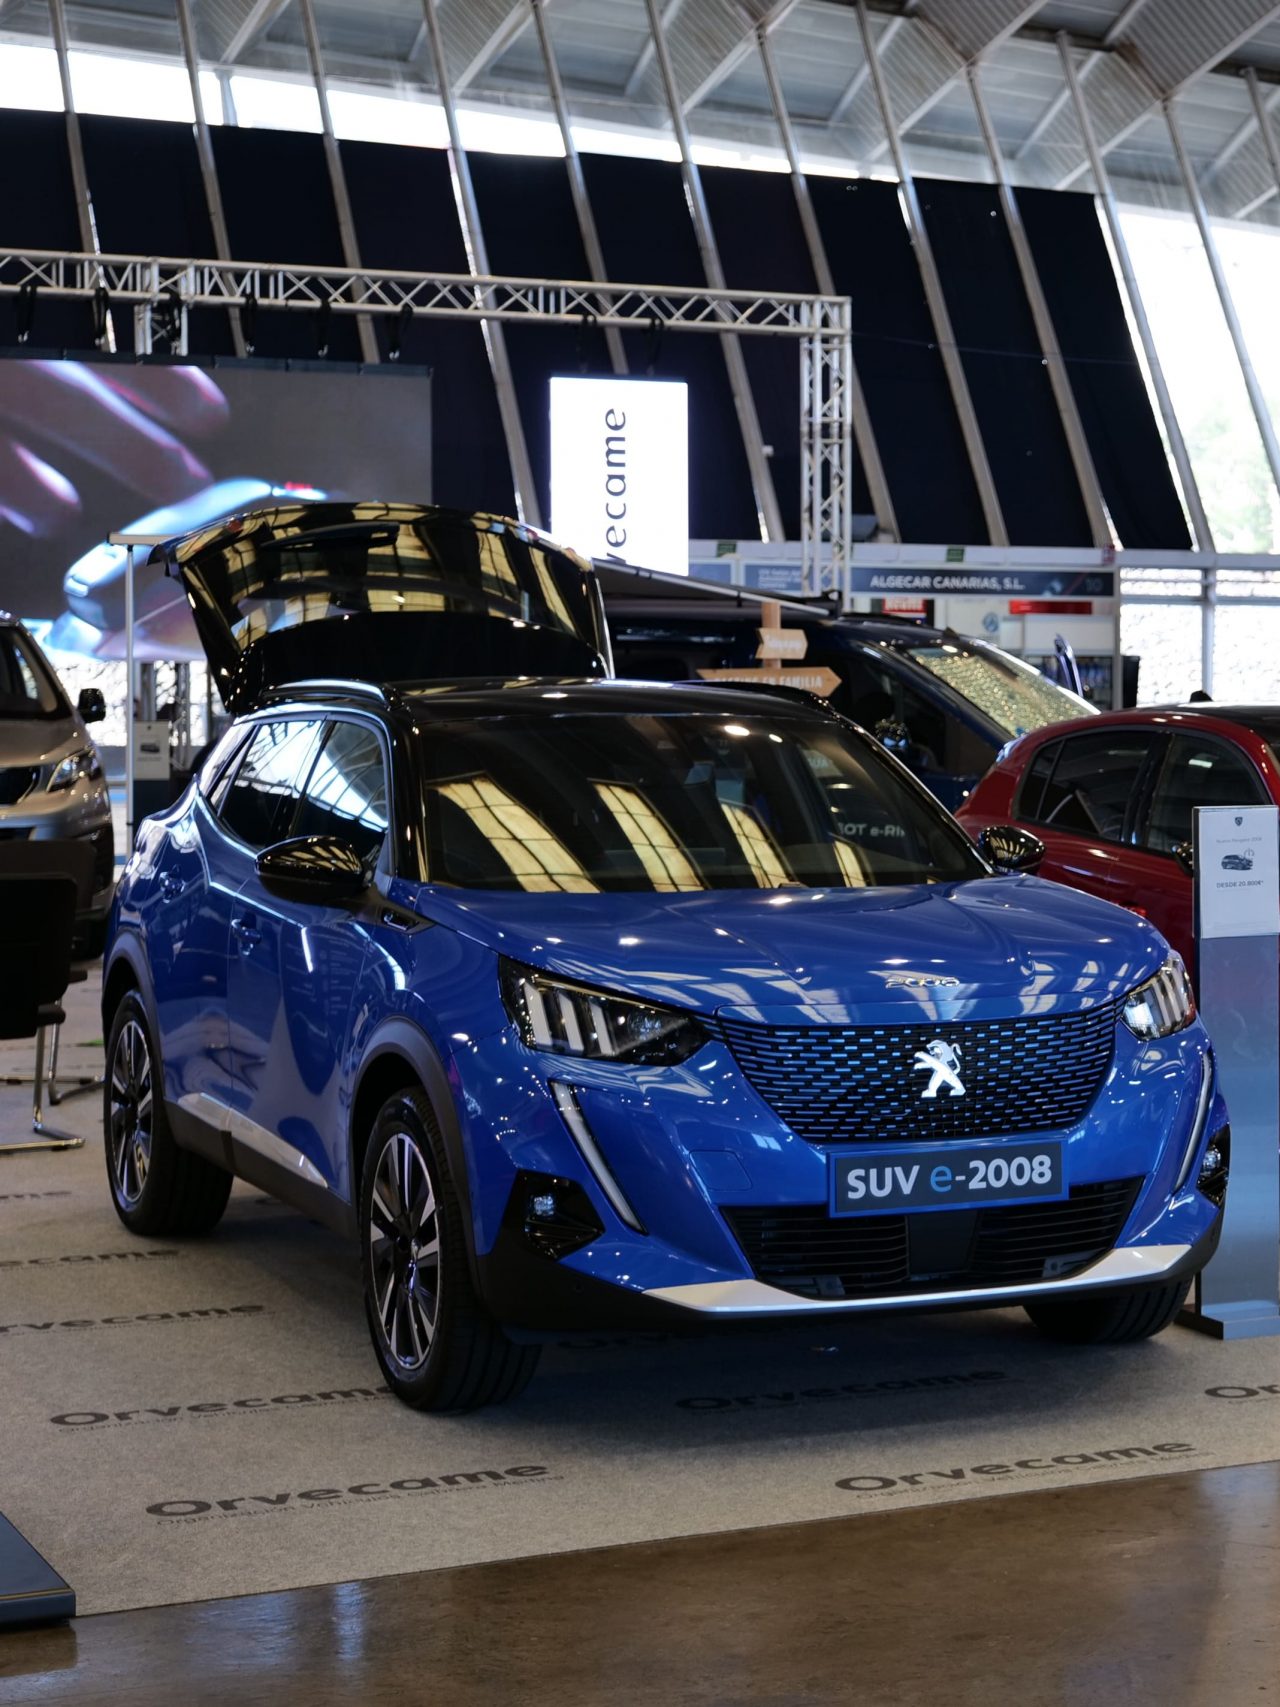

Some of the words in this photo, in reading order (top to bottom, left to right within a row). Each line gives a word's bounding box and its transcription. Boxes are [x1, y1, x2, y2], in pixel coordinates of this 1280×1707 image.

[870, 575, 931, 589] ALGECAR
[933, 576, 1002, 591] CANARIAS,
[1003, 577, 1026, 590] S.L.
[847, 1165, 920, 1199] SUV
[930, 1155, 1053, 1193] e-2008
[675, 1367, 1007, 1411] Orvecame
[835, 1442, 1197, 1491] Orvecame
[146, 1465, 549, 1517] Orvecame
